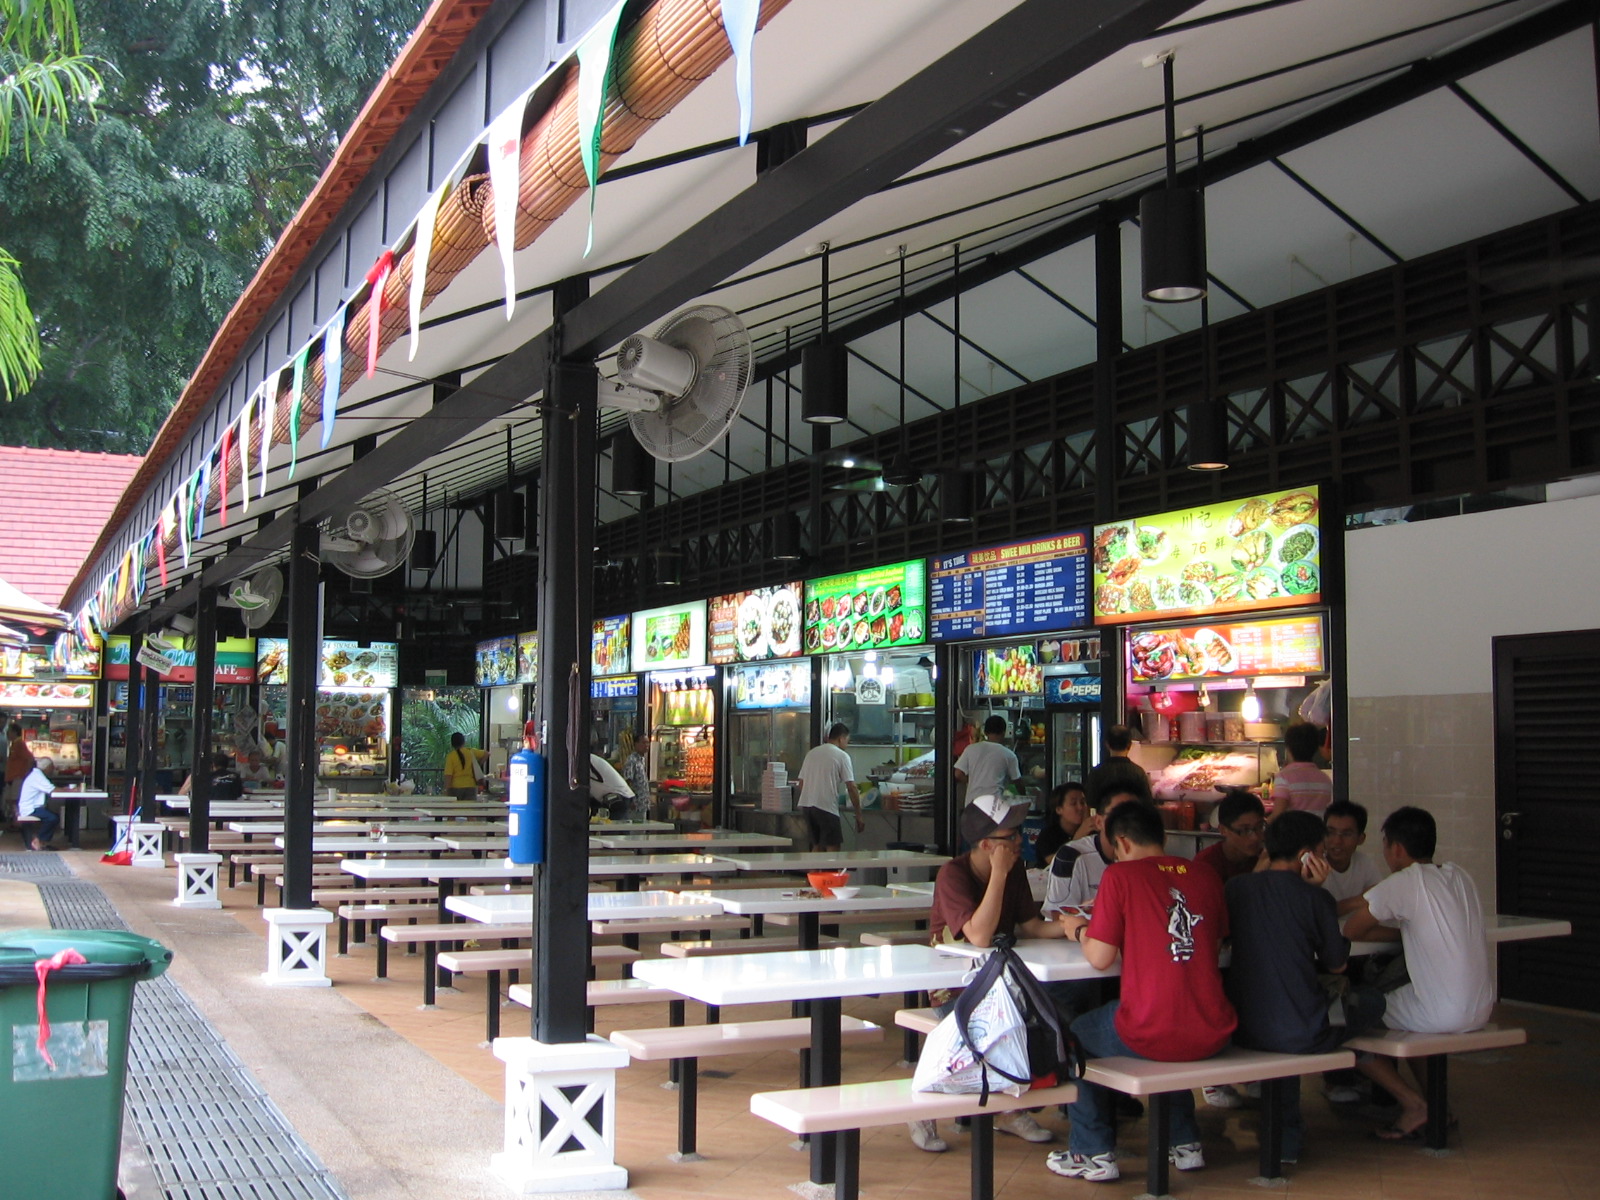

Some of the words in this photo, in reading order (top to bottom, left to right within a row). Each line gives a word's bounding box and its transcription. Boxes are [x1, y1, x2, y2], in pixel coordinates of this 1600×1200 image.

[1000, 548, 1018, 559] SWEE
[1031, 541, 1056, 554] DRINKS
[1056, 539, 1062, 549] &
[1063, 536, 1081, 549] BEER
[1191, 541, 1208, 555] 76
[215, 664, 238, 675] AFE
[1072, 684, 1101, 696] PEPSI
